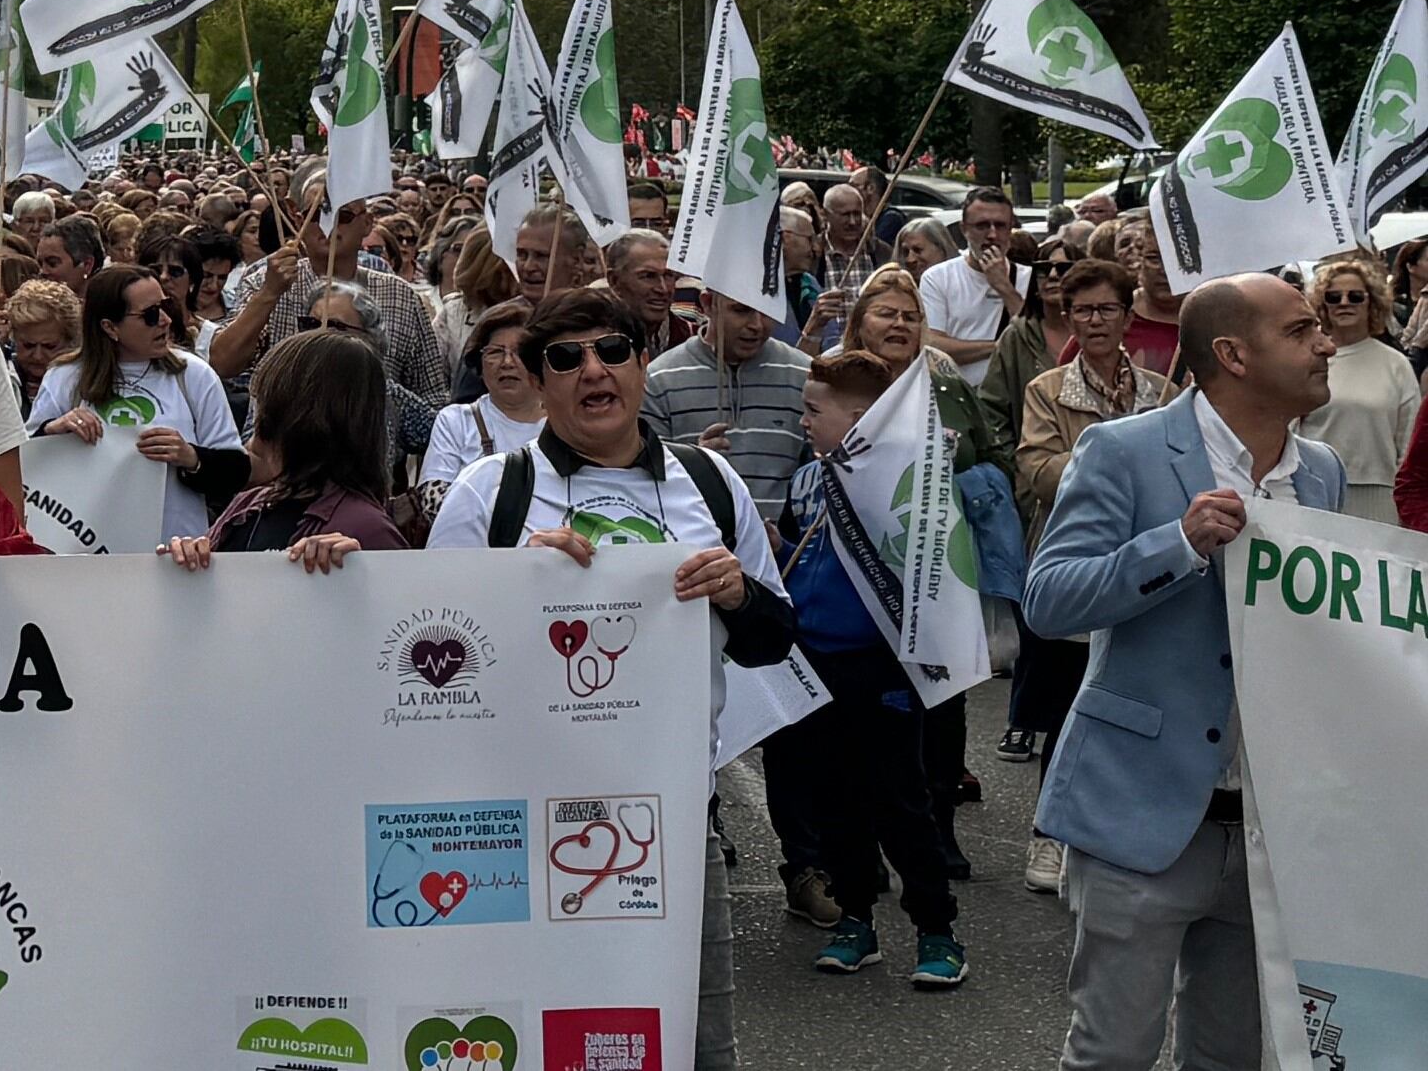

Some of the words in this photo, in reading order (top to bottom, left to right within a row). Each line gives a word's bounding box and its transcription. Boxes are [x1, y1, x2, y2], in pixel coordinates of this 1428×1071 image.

[1245, 538, 1363, 623] POR
[1378, 560, 1428, 639] LA
[543, 604, 594, 613] PLATAFORMA
[596, 603, 607, 611] EN
[609, 601, 642, 610] DEFENSA
[377, 608, 433, 671] SANIDAD
[398, 692, 416, 706] LA
[421, 691, 481, 706] RAMBLA
[561, 704, 570, 712] LA
[378, 812, 456, 825] PLATAFORMA
[459, 814, 470, 822] en
[473, 810, 522, 821] DEFENSA
[380, 830, 392, 840] de
[395, 830, 404, 839] la
[406, 826, 462, 839] SANIDAD
[465, 822, 520, 835] PÚBLICA
[432, 839, 522, 852] MONTEMAYOR
[618, 875, 658, 887] Priego
[267, 995, 336, 1009] DEFIENDE
